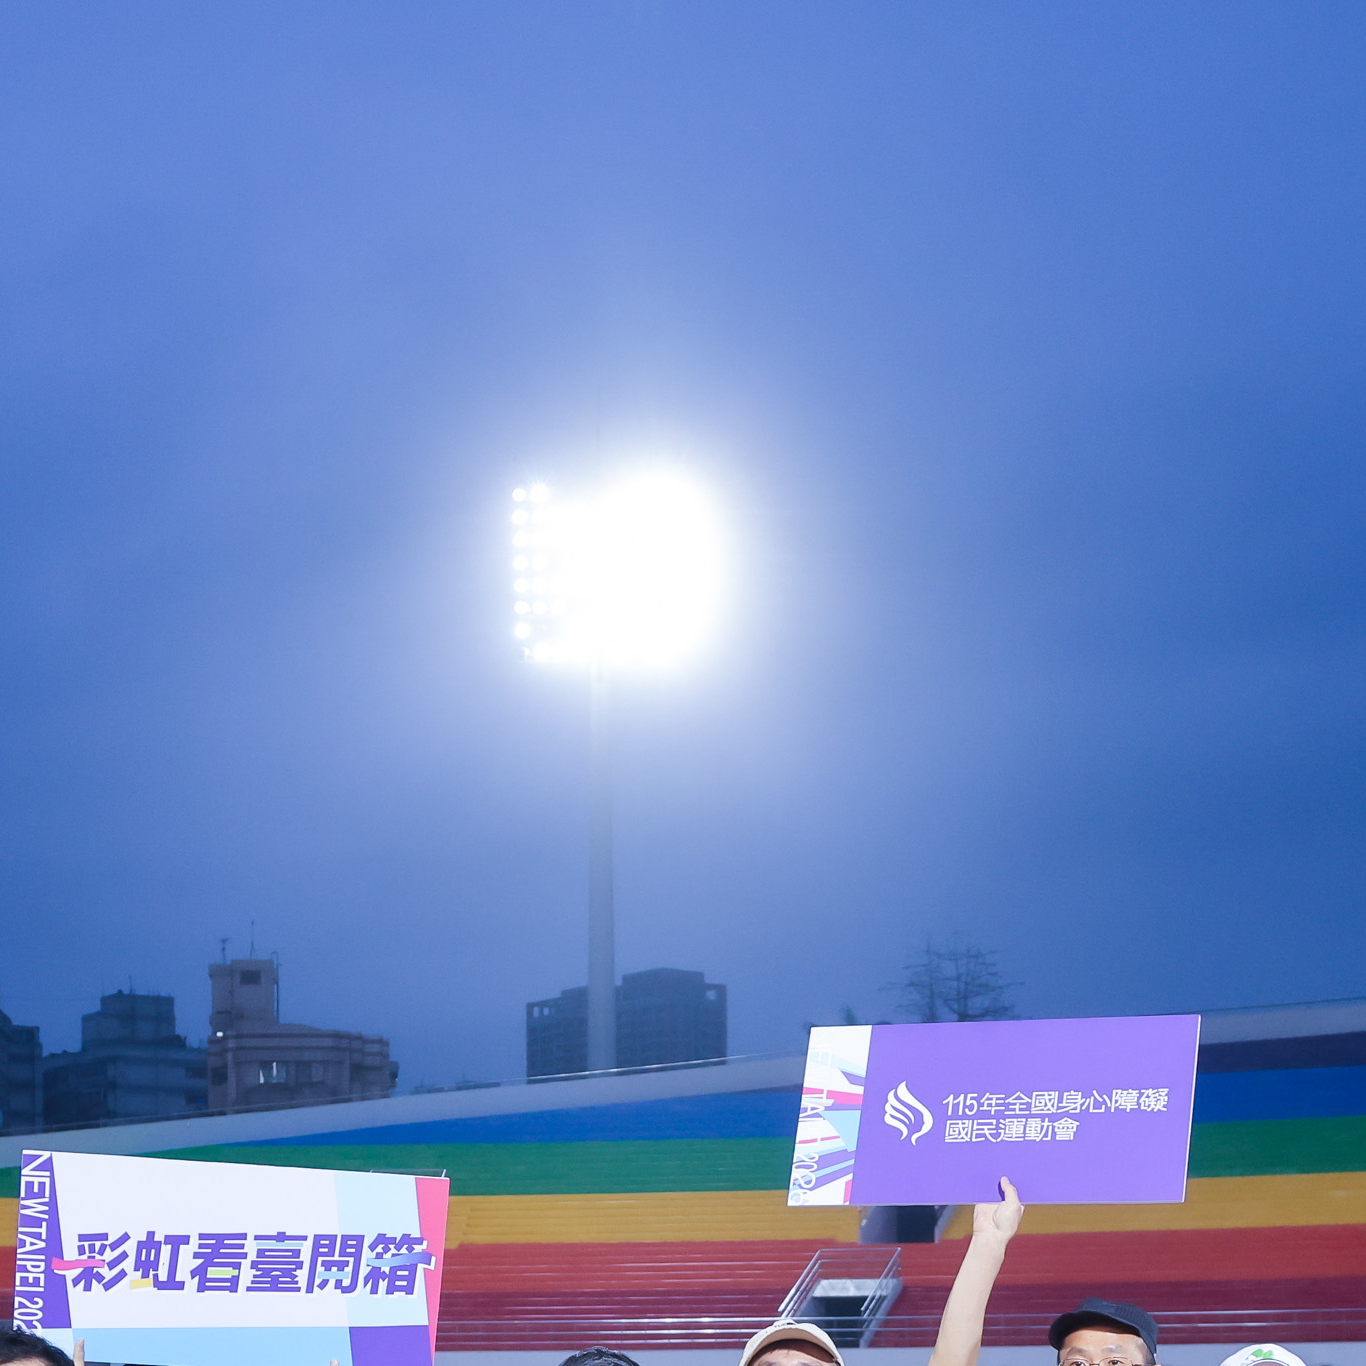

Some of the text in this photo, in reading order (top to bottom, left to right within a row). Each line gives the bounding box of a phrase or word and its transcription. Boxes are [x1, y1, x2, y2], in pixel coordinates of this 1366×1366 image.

[942, 1087, 1170, 1117] 115年全國身心障礙
[944, 1116, 1080, 1143] 國民運動會
[13, 1149, 52, 1335] NEW TAIPEI 202
[51, 1230, 436, 1295] 彩虹看臺開箱
